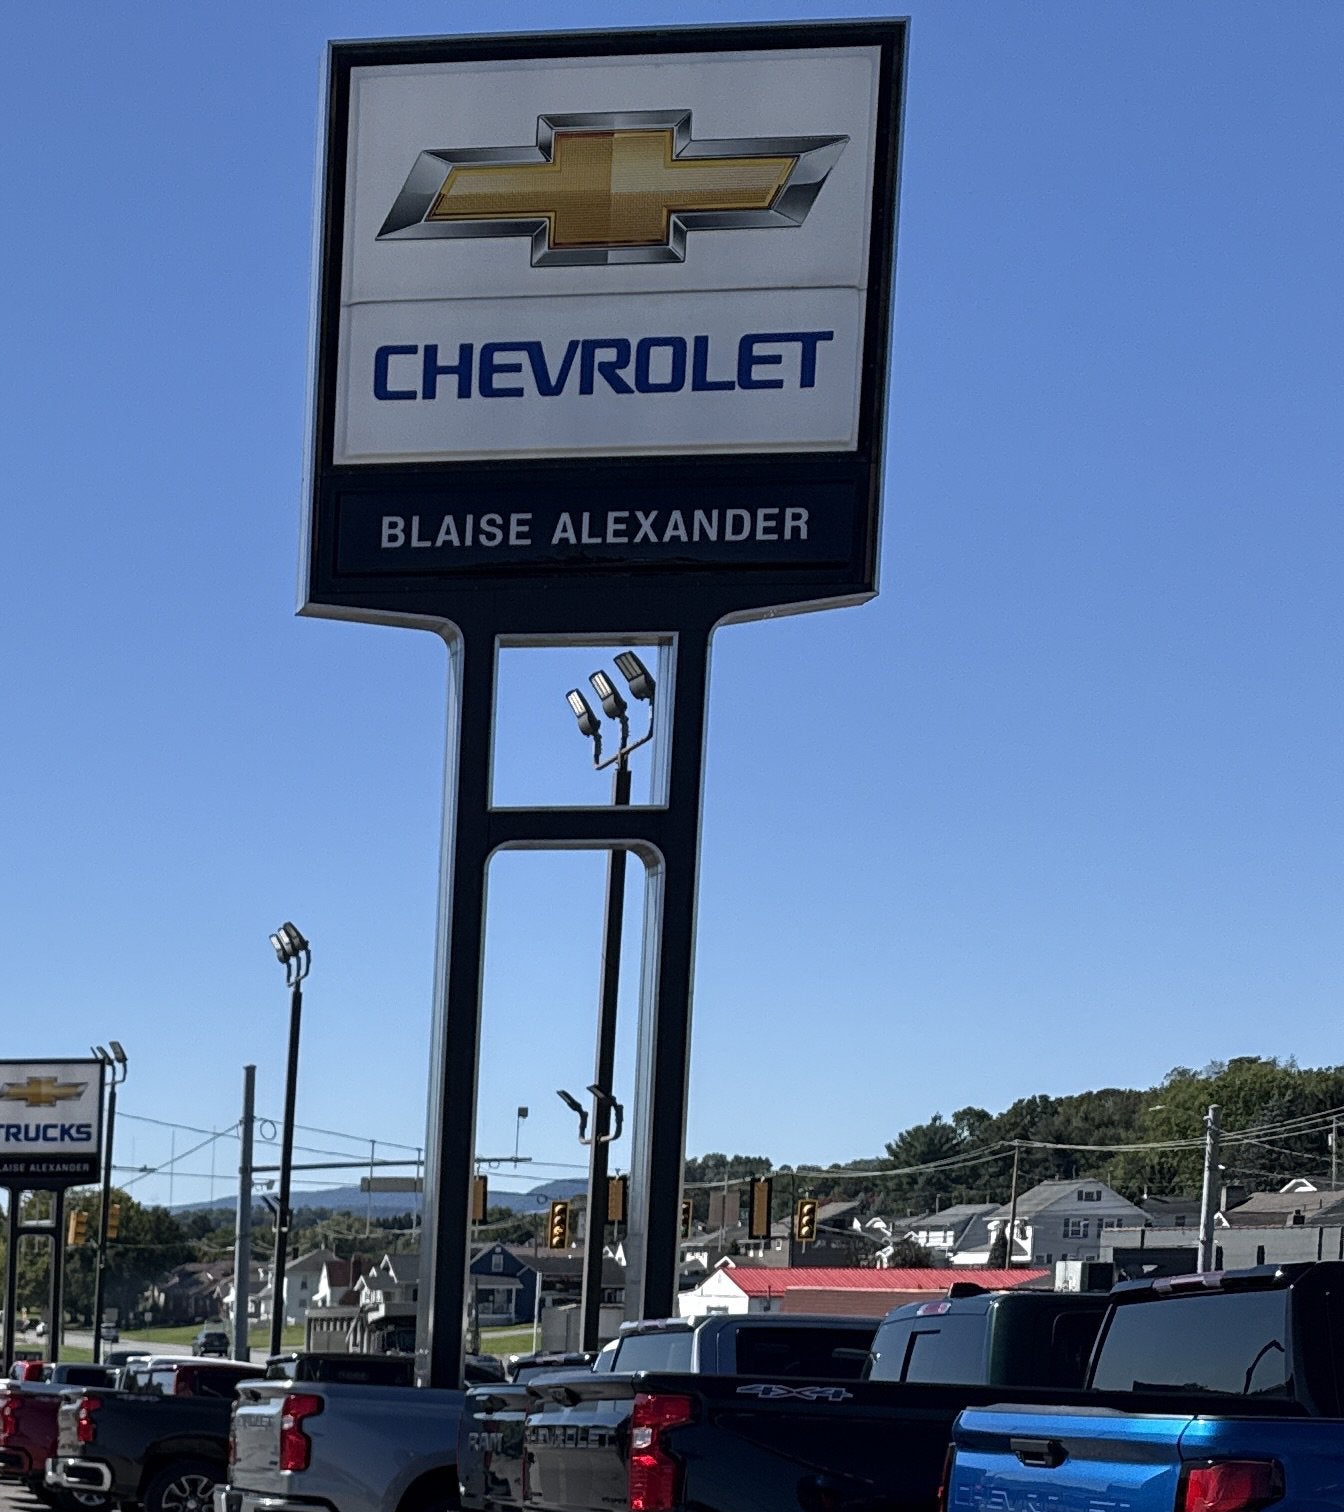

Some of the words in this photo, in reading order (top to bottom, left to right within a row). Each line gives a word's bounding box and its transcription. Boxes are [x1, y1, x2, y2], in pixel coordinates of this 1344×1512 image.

[372, 330, 835, 401] CHEVROLET
[380, 513, 533, 550] BLAISE
[551, 507, 810, 547] ALEXANDER
[29, 1162, 90, 1173] ALEXANDER
[468, 1432, 504, 1452] RAM
